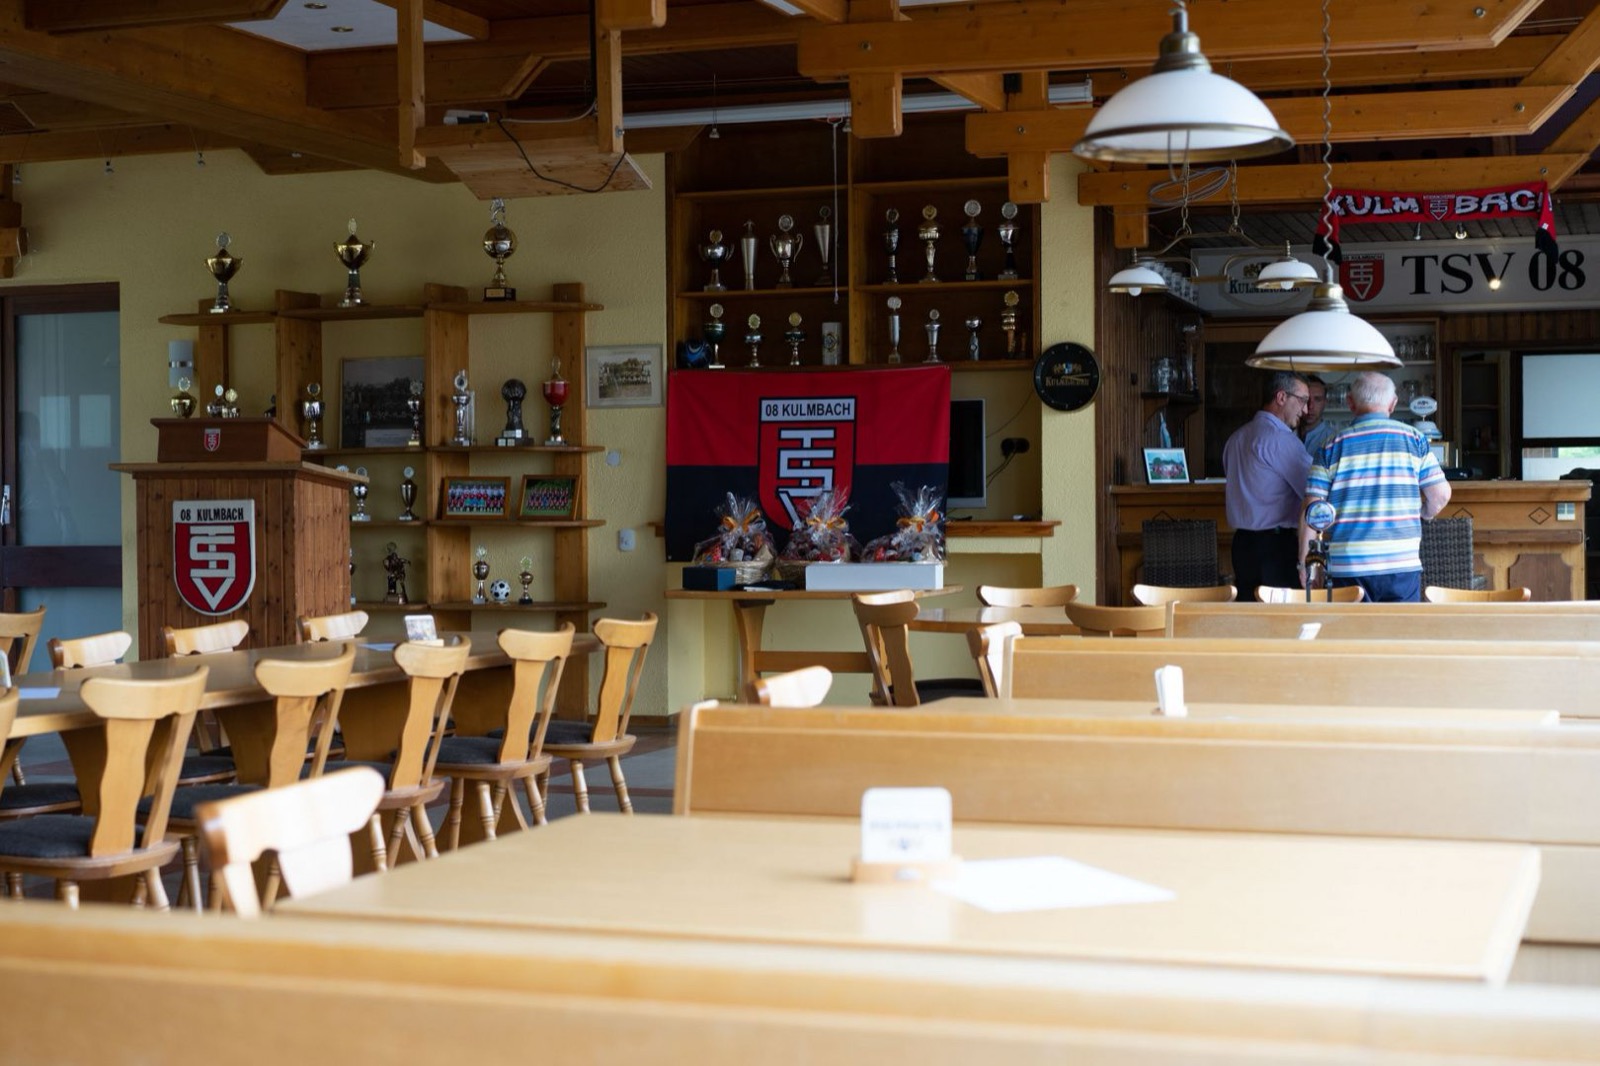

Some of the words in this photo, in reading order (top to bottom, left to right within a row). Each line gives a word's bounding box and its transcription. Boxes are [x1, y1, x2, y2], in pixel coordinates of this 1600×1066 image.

[1455, 190, 1552, 214] BAC
[1401, 252, 1516, 295] TSV
[1529, 249, 1586, 291] 08
[765, 404, 779, 417] 08
[782, 403, 851, 417] KULMBACH
[180, 508, 191, 521] 08
[197, 508, 243, 521] KULMBACH
